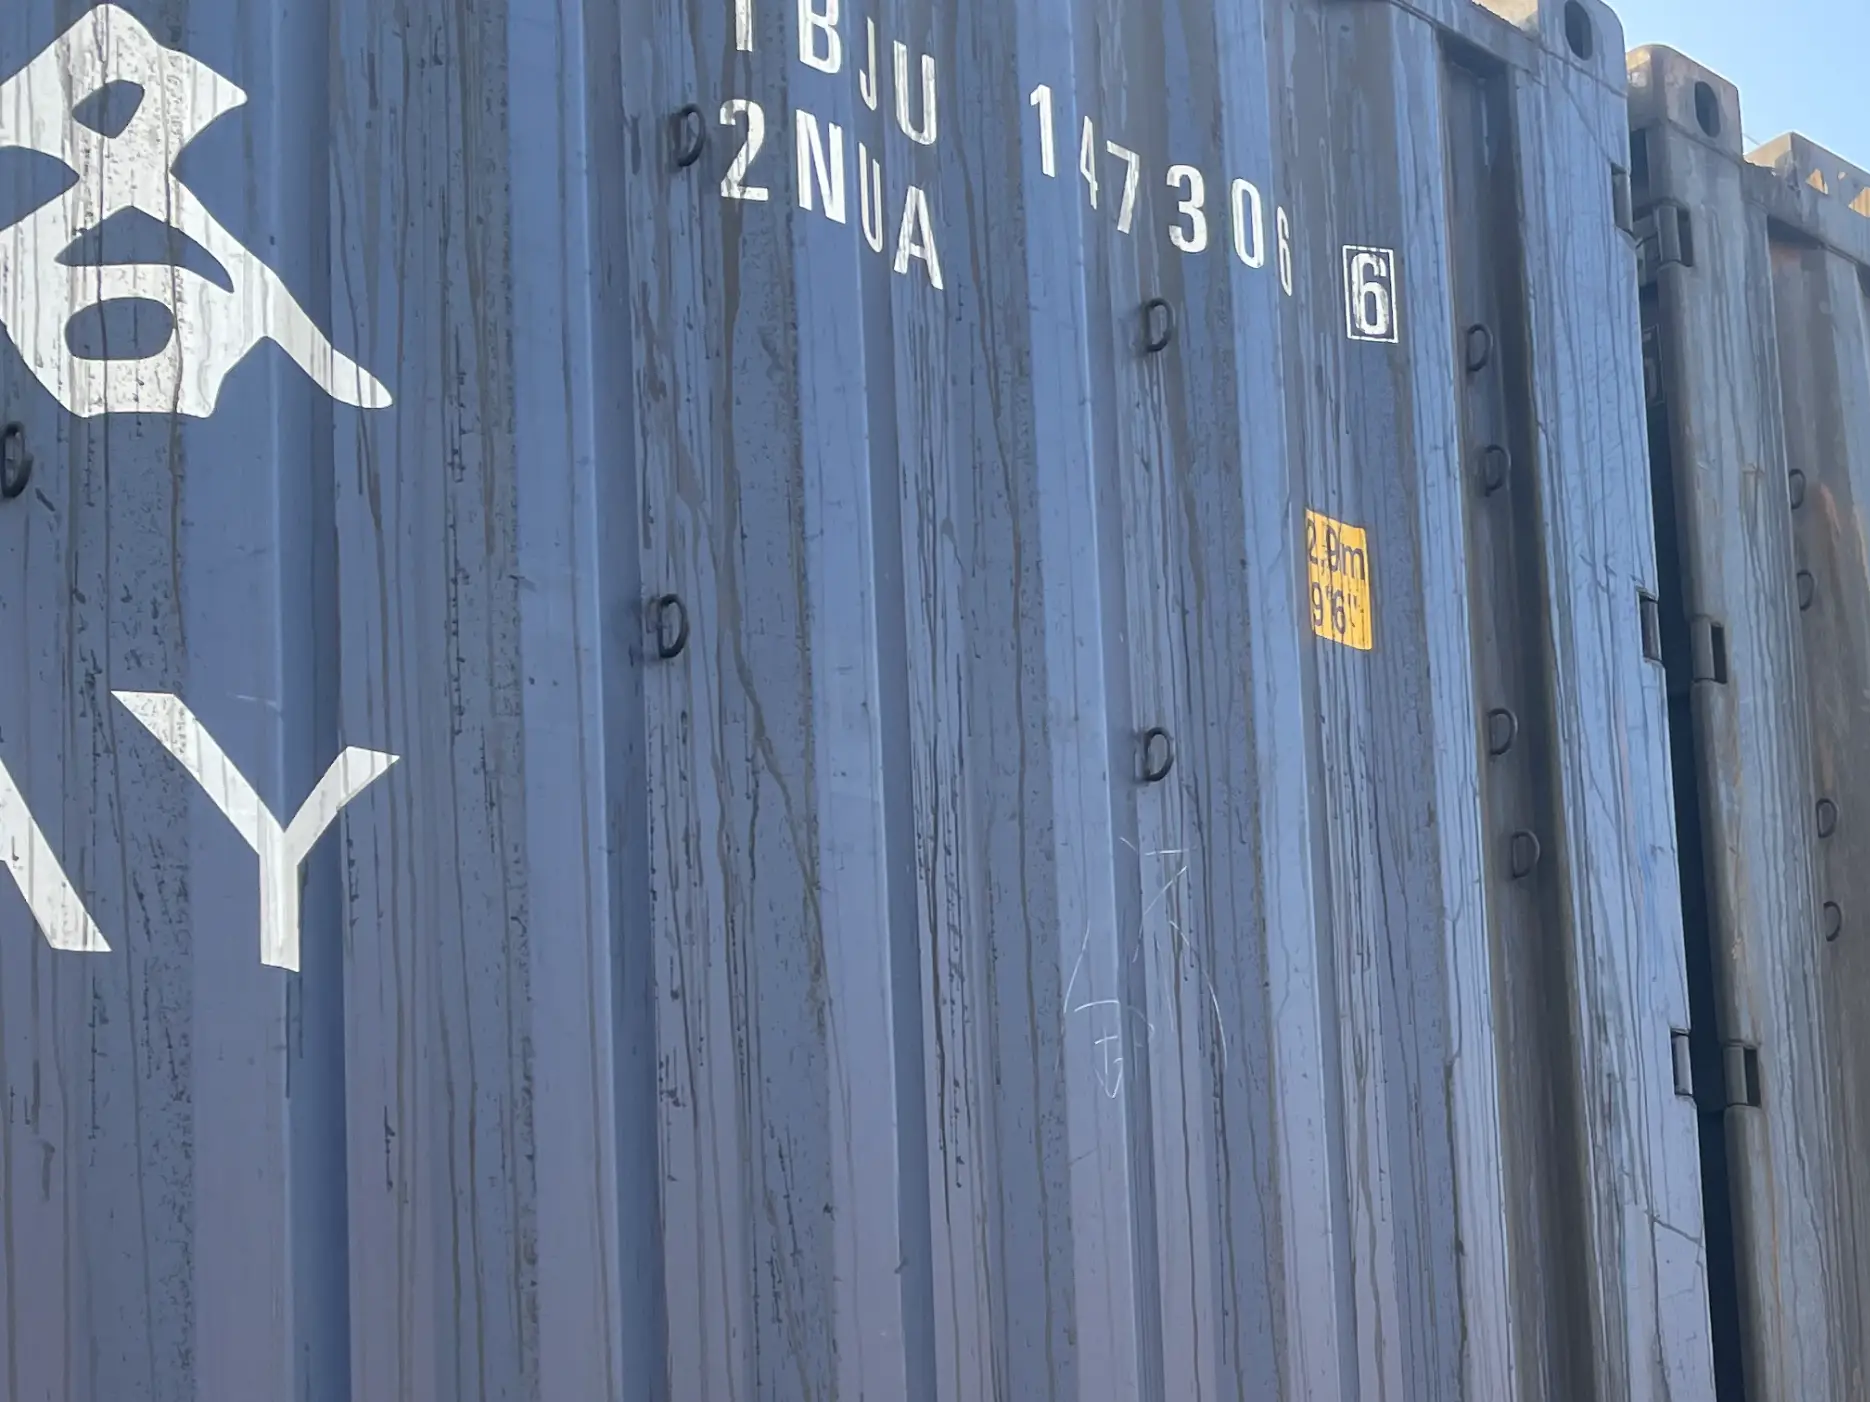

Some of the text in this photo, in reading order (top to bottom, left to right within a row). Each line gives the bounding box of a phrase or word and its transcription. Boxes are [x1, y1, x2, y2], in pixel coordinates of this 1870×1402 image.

[719, 98, 944, 290] 2NUA
[1029, 84, 1294, 297] 147306
[1346, 248, 1394, 340] 6
